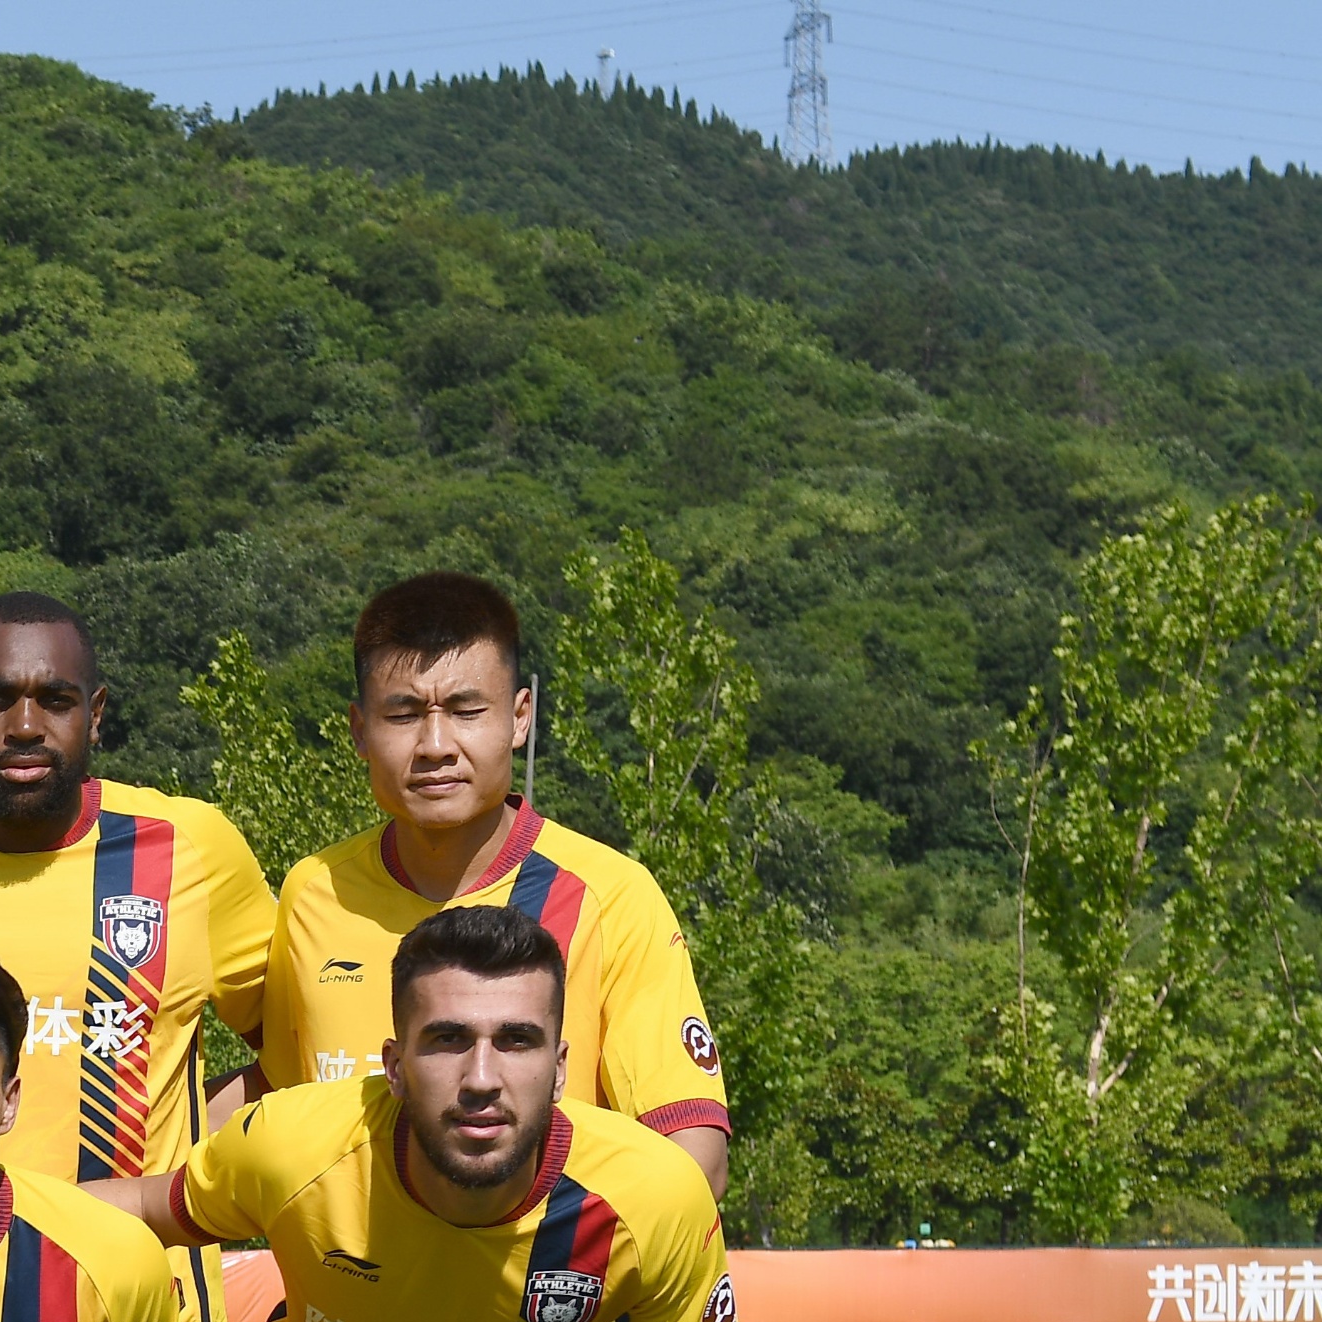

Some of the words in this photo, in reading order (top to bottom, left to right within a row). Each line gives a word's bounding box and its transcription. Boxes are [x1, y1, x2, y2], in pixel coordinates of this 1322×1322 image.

[318, 973, 364, 984] LI-NING
[321, 1257, 380, 1283] LI-NING
[534, 1280, 595, 1293] ATHLETIC
